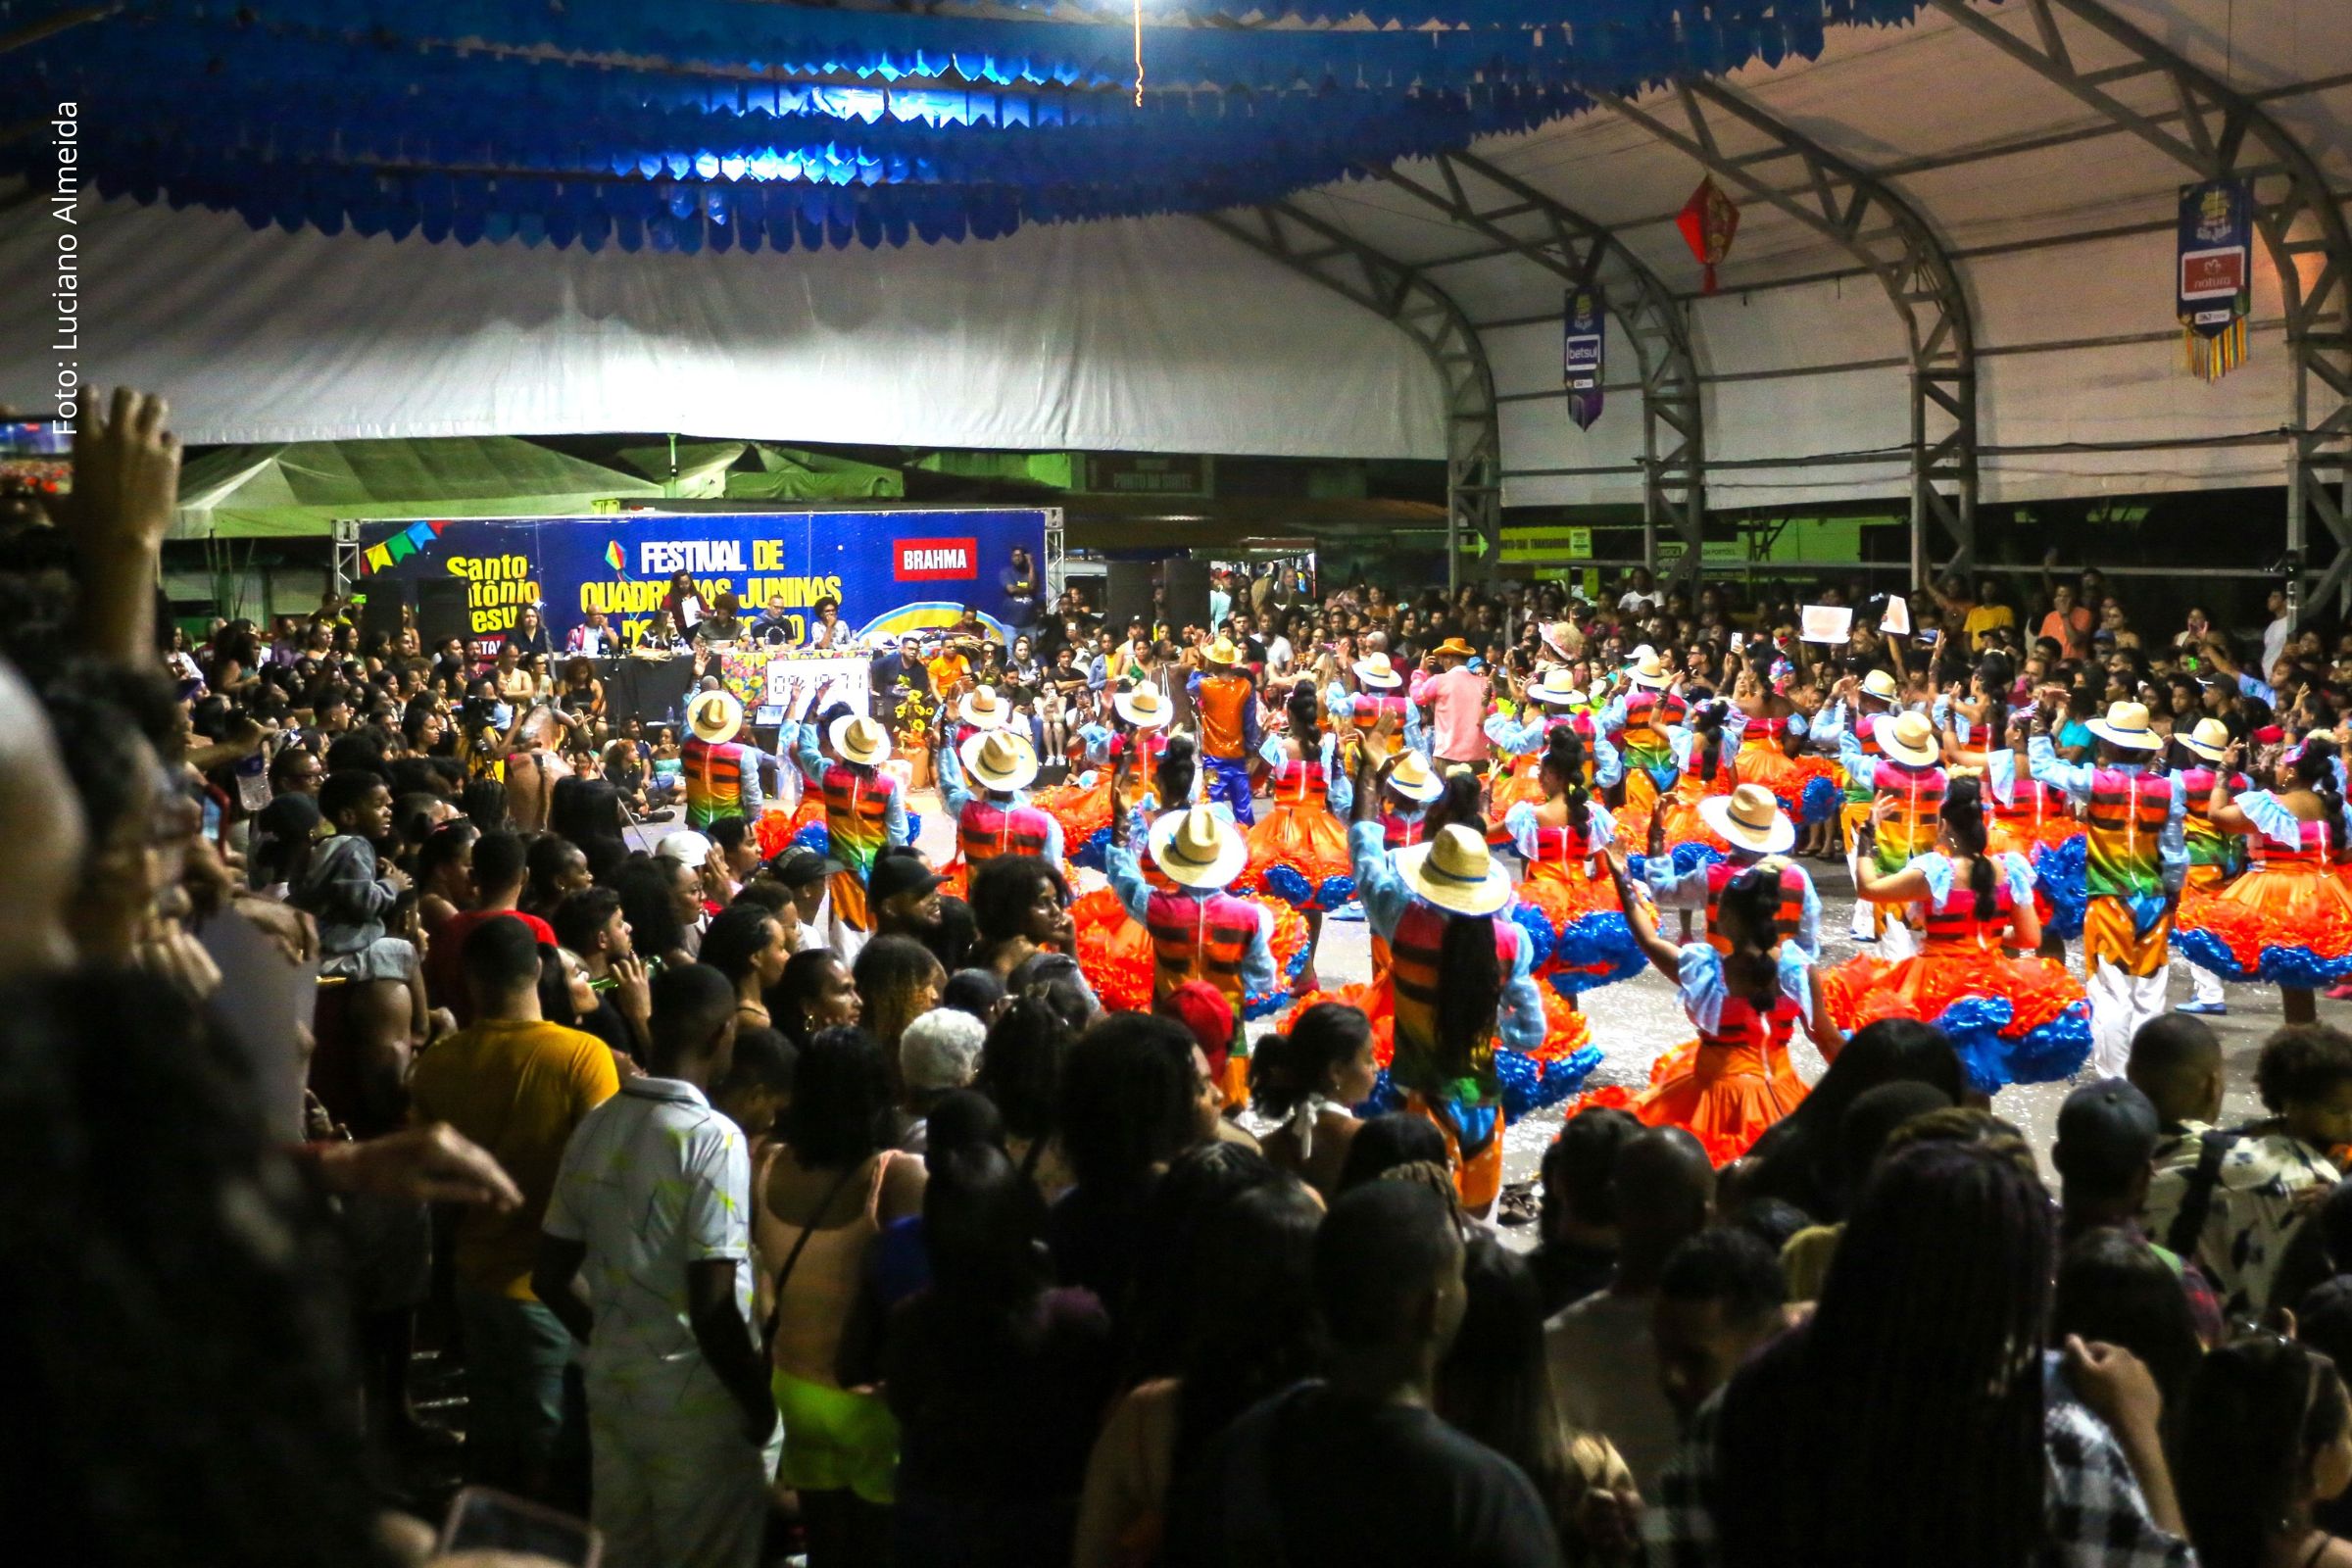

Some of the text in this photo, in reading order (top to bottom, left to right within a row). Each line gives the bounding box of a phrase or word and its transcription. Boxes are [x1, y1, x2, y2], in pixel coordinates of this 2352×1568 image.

[2194, 275, 2231, 288] natura
[1569, 345, 1597, 360] betsul
[446, 554, 528, 581] Santo
[640, 539, 784, 573] FESTIVAL DE
[903, 548, 967, 570] BRAHMA
[468, 579, 542, 608] tônio
[738, 576, 842, 610] JUNINAS
